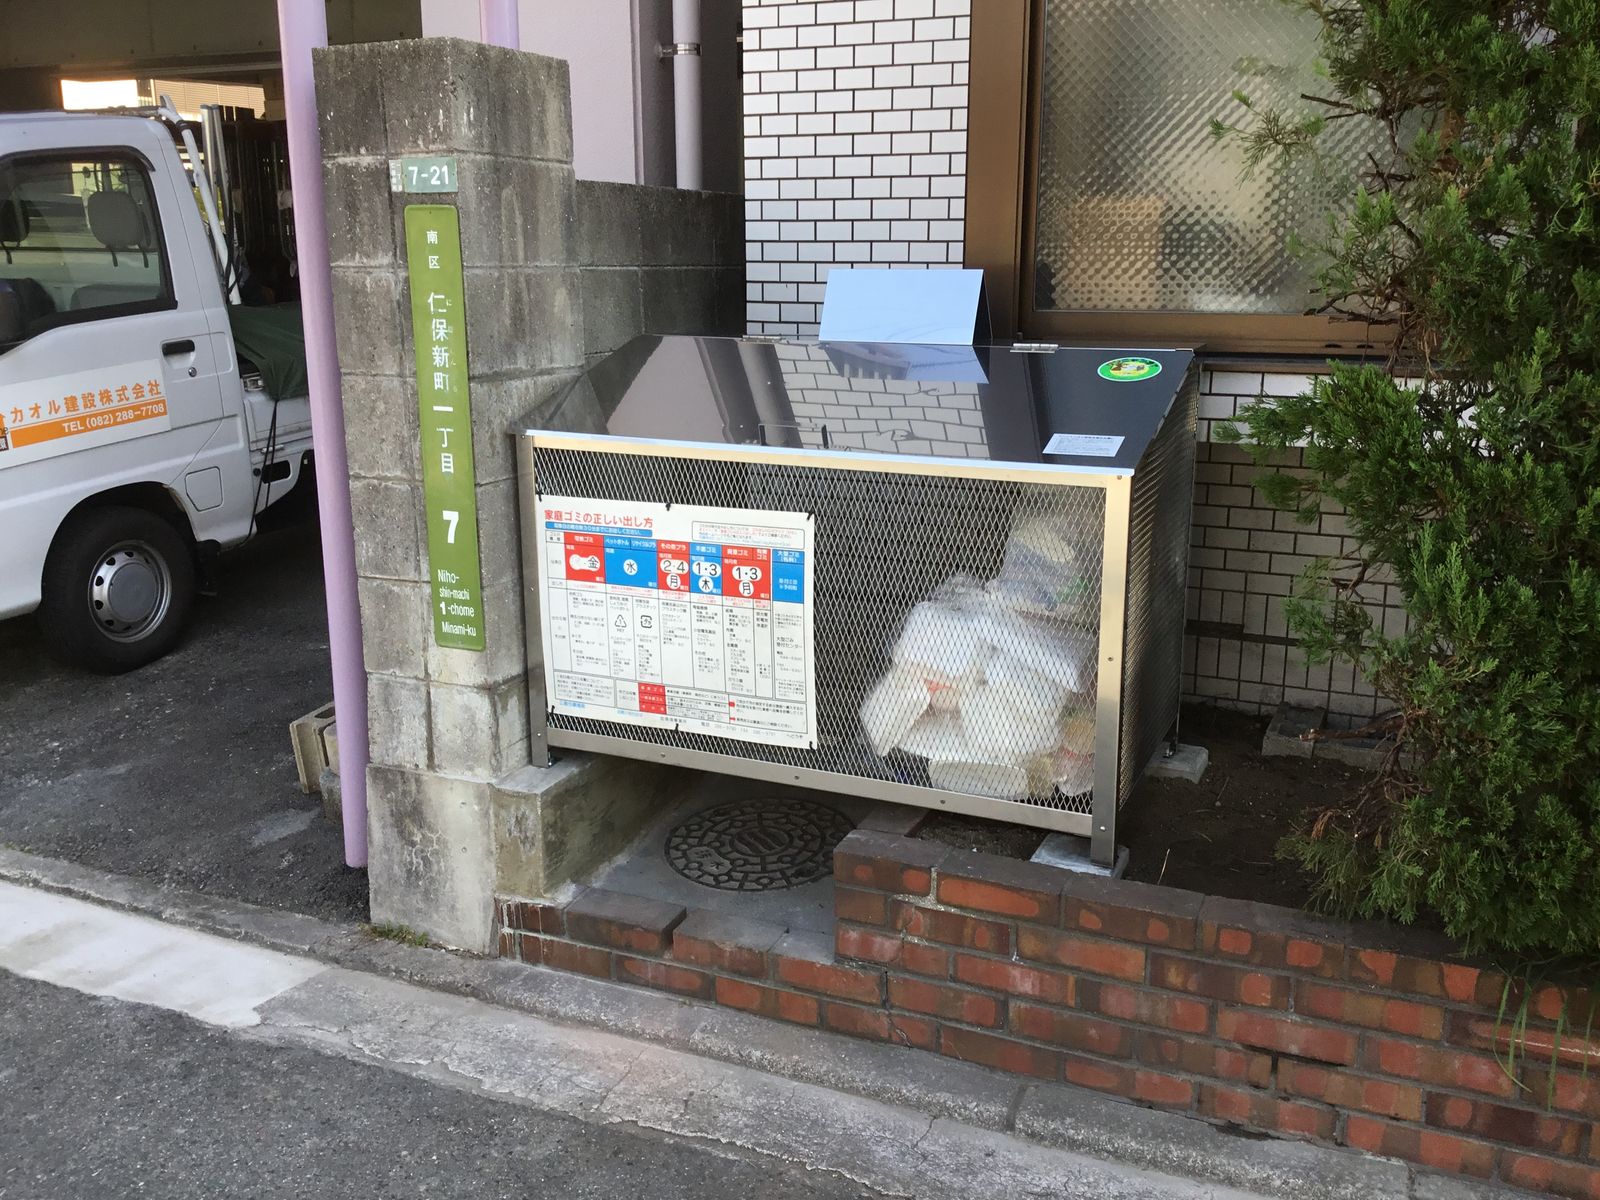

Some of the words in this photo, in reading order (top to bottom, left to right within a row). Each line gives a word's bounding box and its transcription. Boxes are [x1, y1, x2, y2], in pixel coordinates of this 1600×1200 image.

[408, 165, 449, 185] 7-21
[427, 230, 441, 269] 南区
[442, 510, 460, 544] 7
[11, 379, 162, 424] カオル建設株式会社
[62, 421, 85, 433] TEL
[86, 414, 114, 429] (082)
[116, 402, 165, 422] 288-7708
[544, 509, 654, 528] 家庭ゴミの正しい出し方
[626, 562, 637, 573] 水
[437, 568, 460, 584] Niho-
[670, 574, 678, 588] 月
[702, 578, 710, 590] 木
[439, 586, 470, 600] shin-machi
[743, 581, 751, 595] 月
[441, 621, 477, 637] Minami-ku
